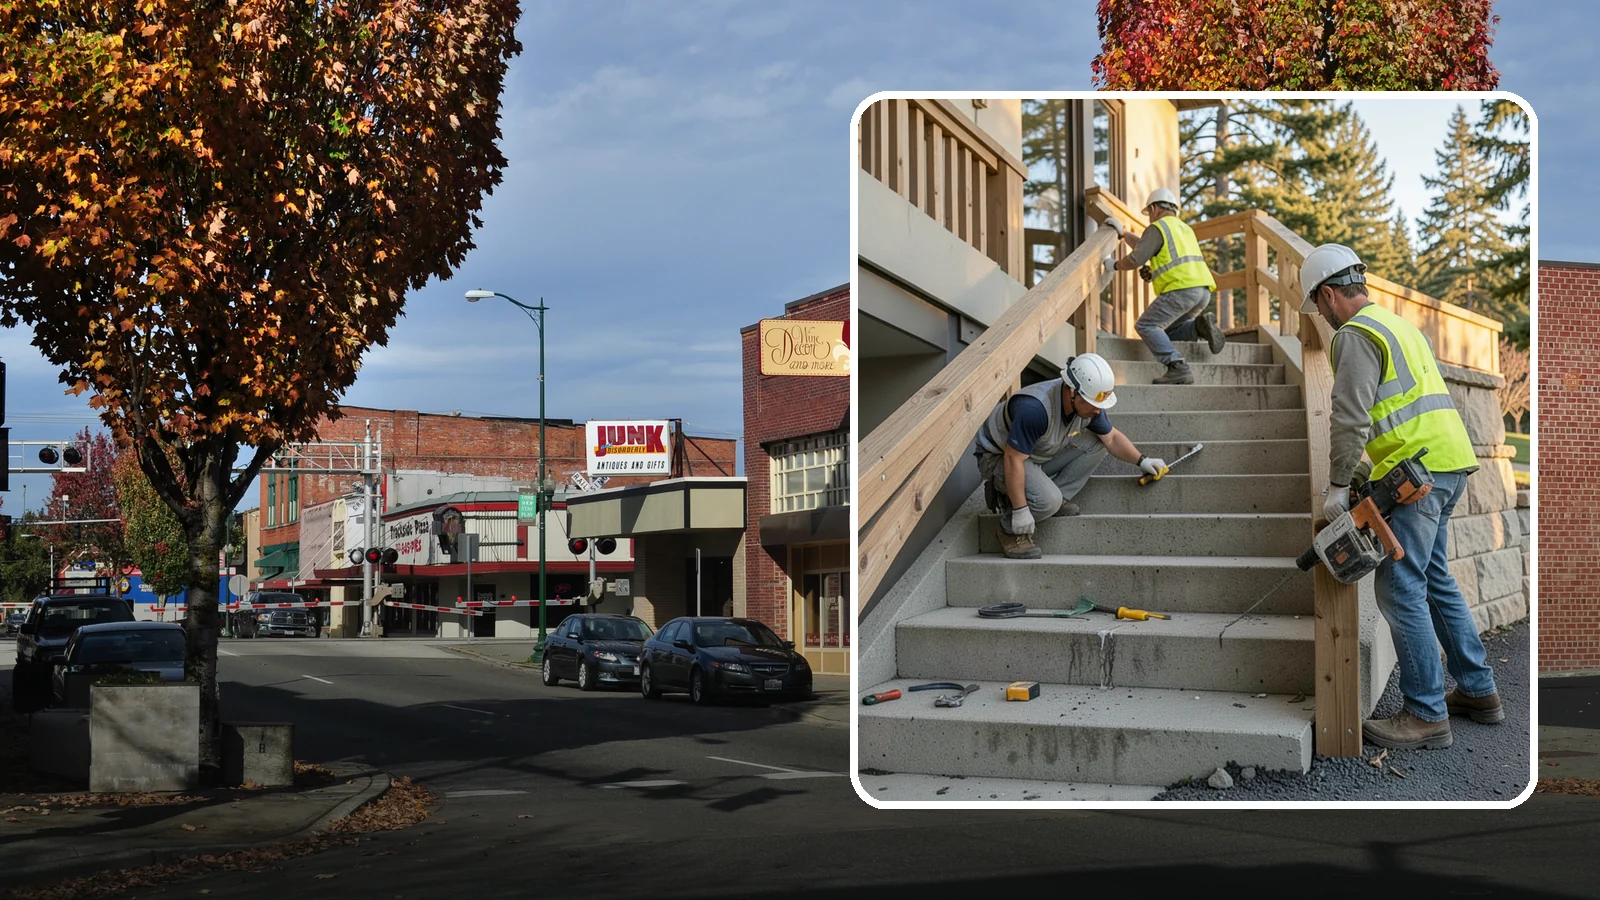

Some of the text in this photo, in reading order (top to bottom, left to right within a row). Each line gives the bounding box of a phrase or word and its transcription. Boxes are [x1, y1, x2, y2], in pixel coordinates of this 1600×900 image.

[595, 425, 664, 457] JUNK
[607, 446, 646, 454] DISORDERLY
[596, 460, 665, 470] ANTIQUES AND GIFTS
[415, 519, 429, 535] Pizza
